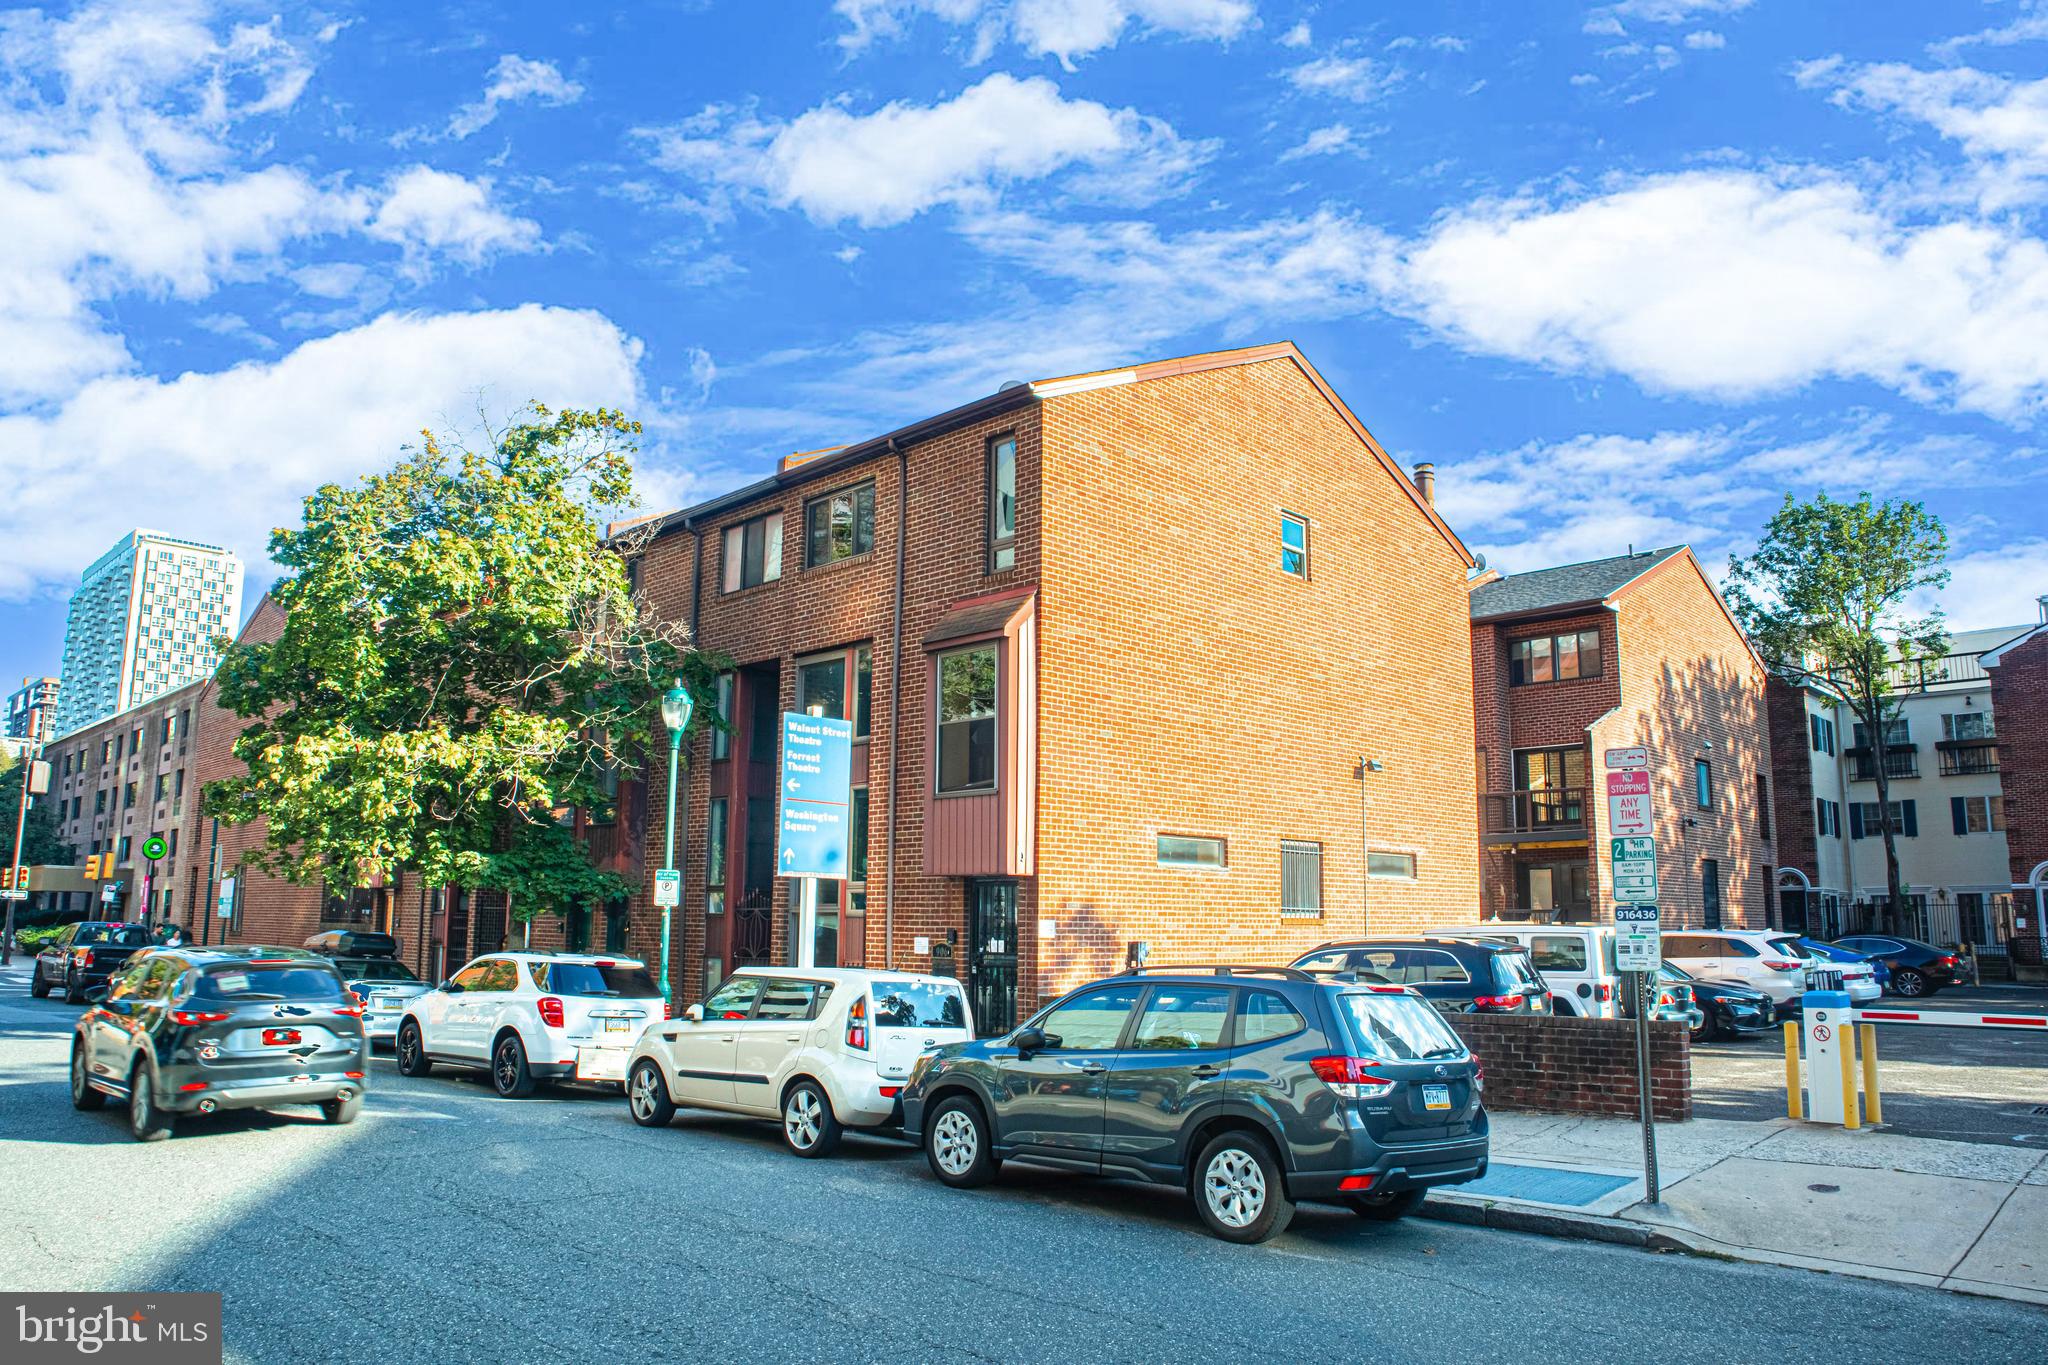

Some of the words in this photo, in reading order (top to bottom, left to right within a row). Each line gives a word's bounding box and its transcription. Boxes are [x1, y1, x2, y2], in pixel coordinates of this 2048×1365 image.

[788, 721, 820, 735] Walnut
[822, 726, 851, 739] Street
[788, 733, 822, 747] Theatre
[786, 750, 821, 763] Forrest
[786, 761, 821, 774] Theatre
[1622, 774, 1633, 783] NO
[1610, 783, 1647, 794] STOPPING
[1620, 798, 1639, 808] ANY
[785, 808, 839, 824] Washington
[1620, 809, 1641, 820] TIME
[784, 820, 817, 833] Square
[1614, 842, 1622, 858] 2
[1633, 839, 1645, 849] HR
[1625, 849, 1653, 859] PARKING
[1639, 877, 1644, 885] 4
[1616, 910, 1656, 920] 916436
